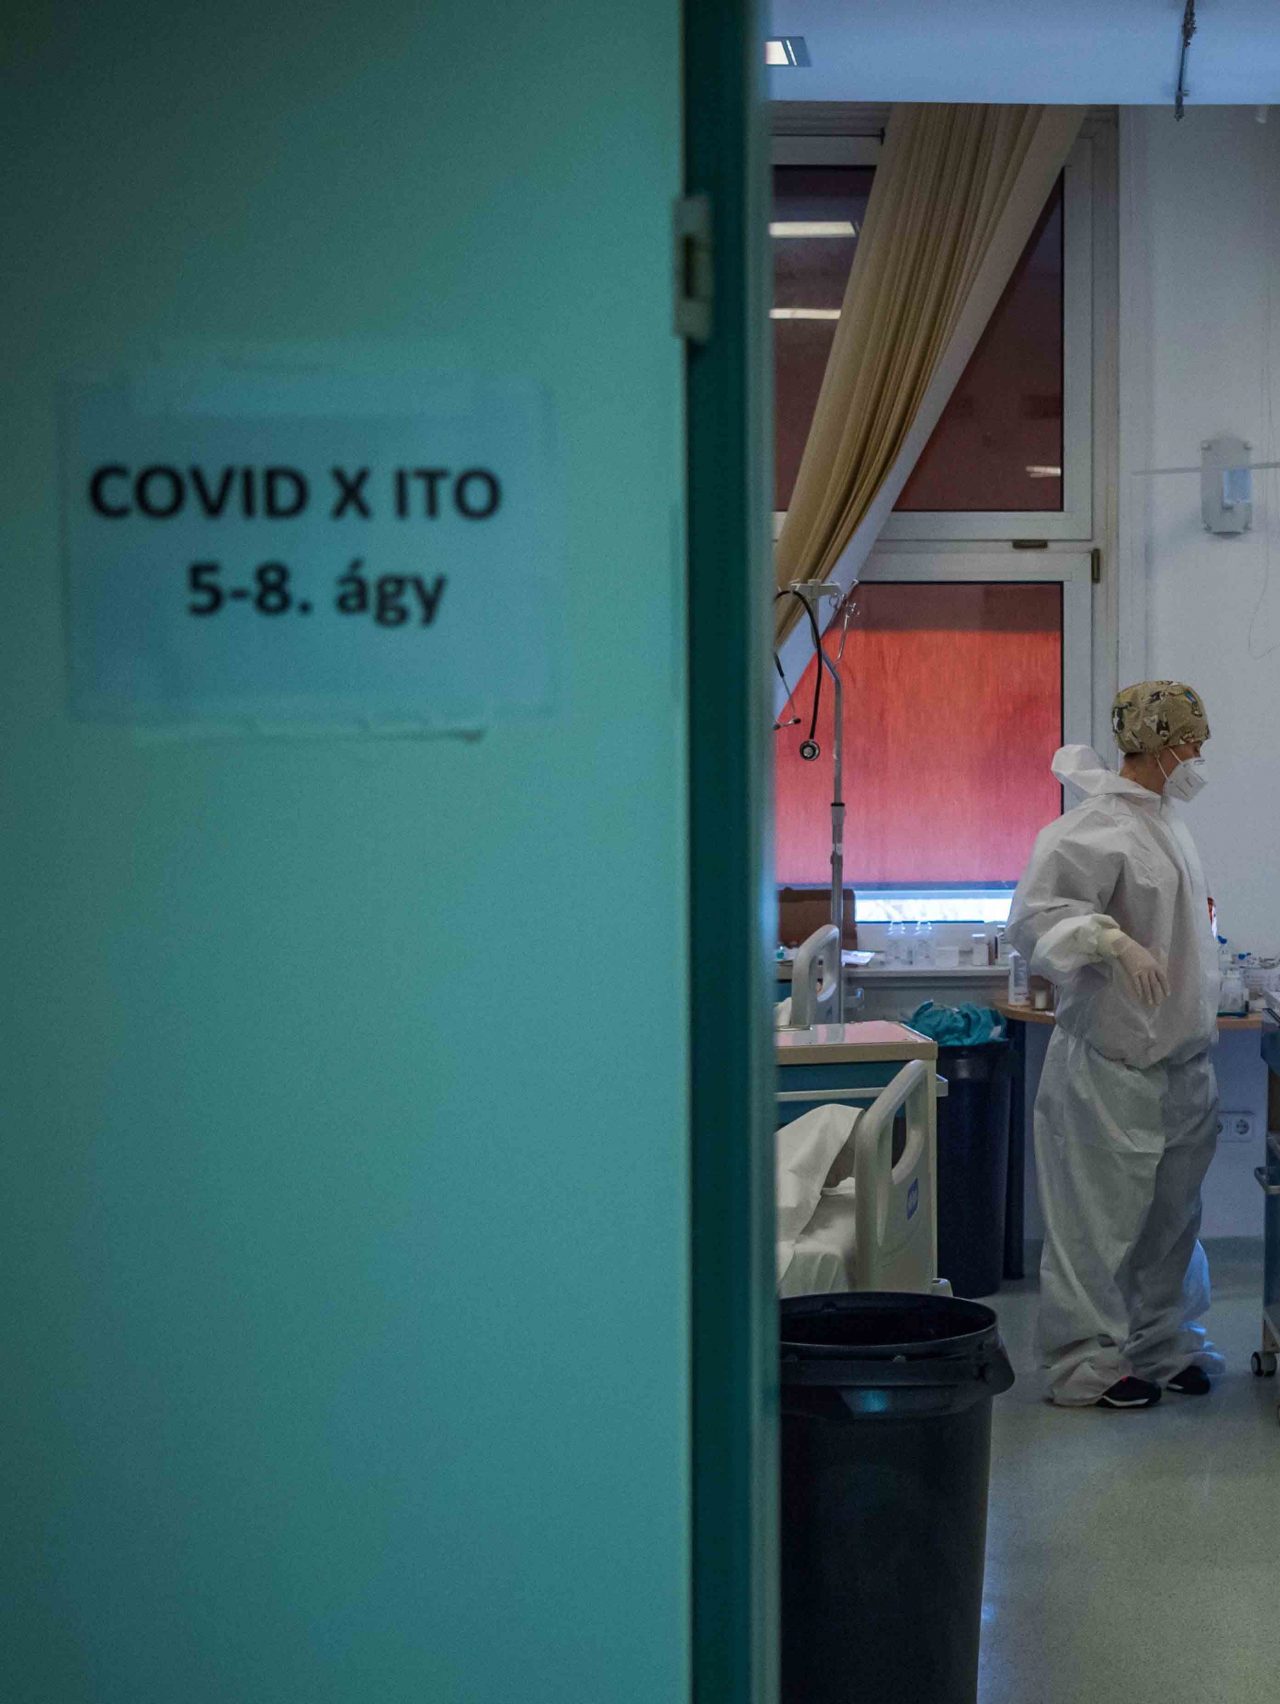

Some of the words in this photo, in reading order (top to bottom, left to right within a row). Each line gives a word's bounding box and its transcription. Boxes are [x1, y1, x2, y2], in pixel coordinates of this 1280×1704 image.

[86, 461, 310, 522] COVID
[331, 467, 371, 520] X
[394, 469, 501, 521] ITO
[186, 561, 312, 616] 5-8.
[335, 560, 446, 627] ágy
